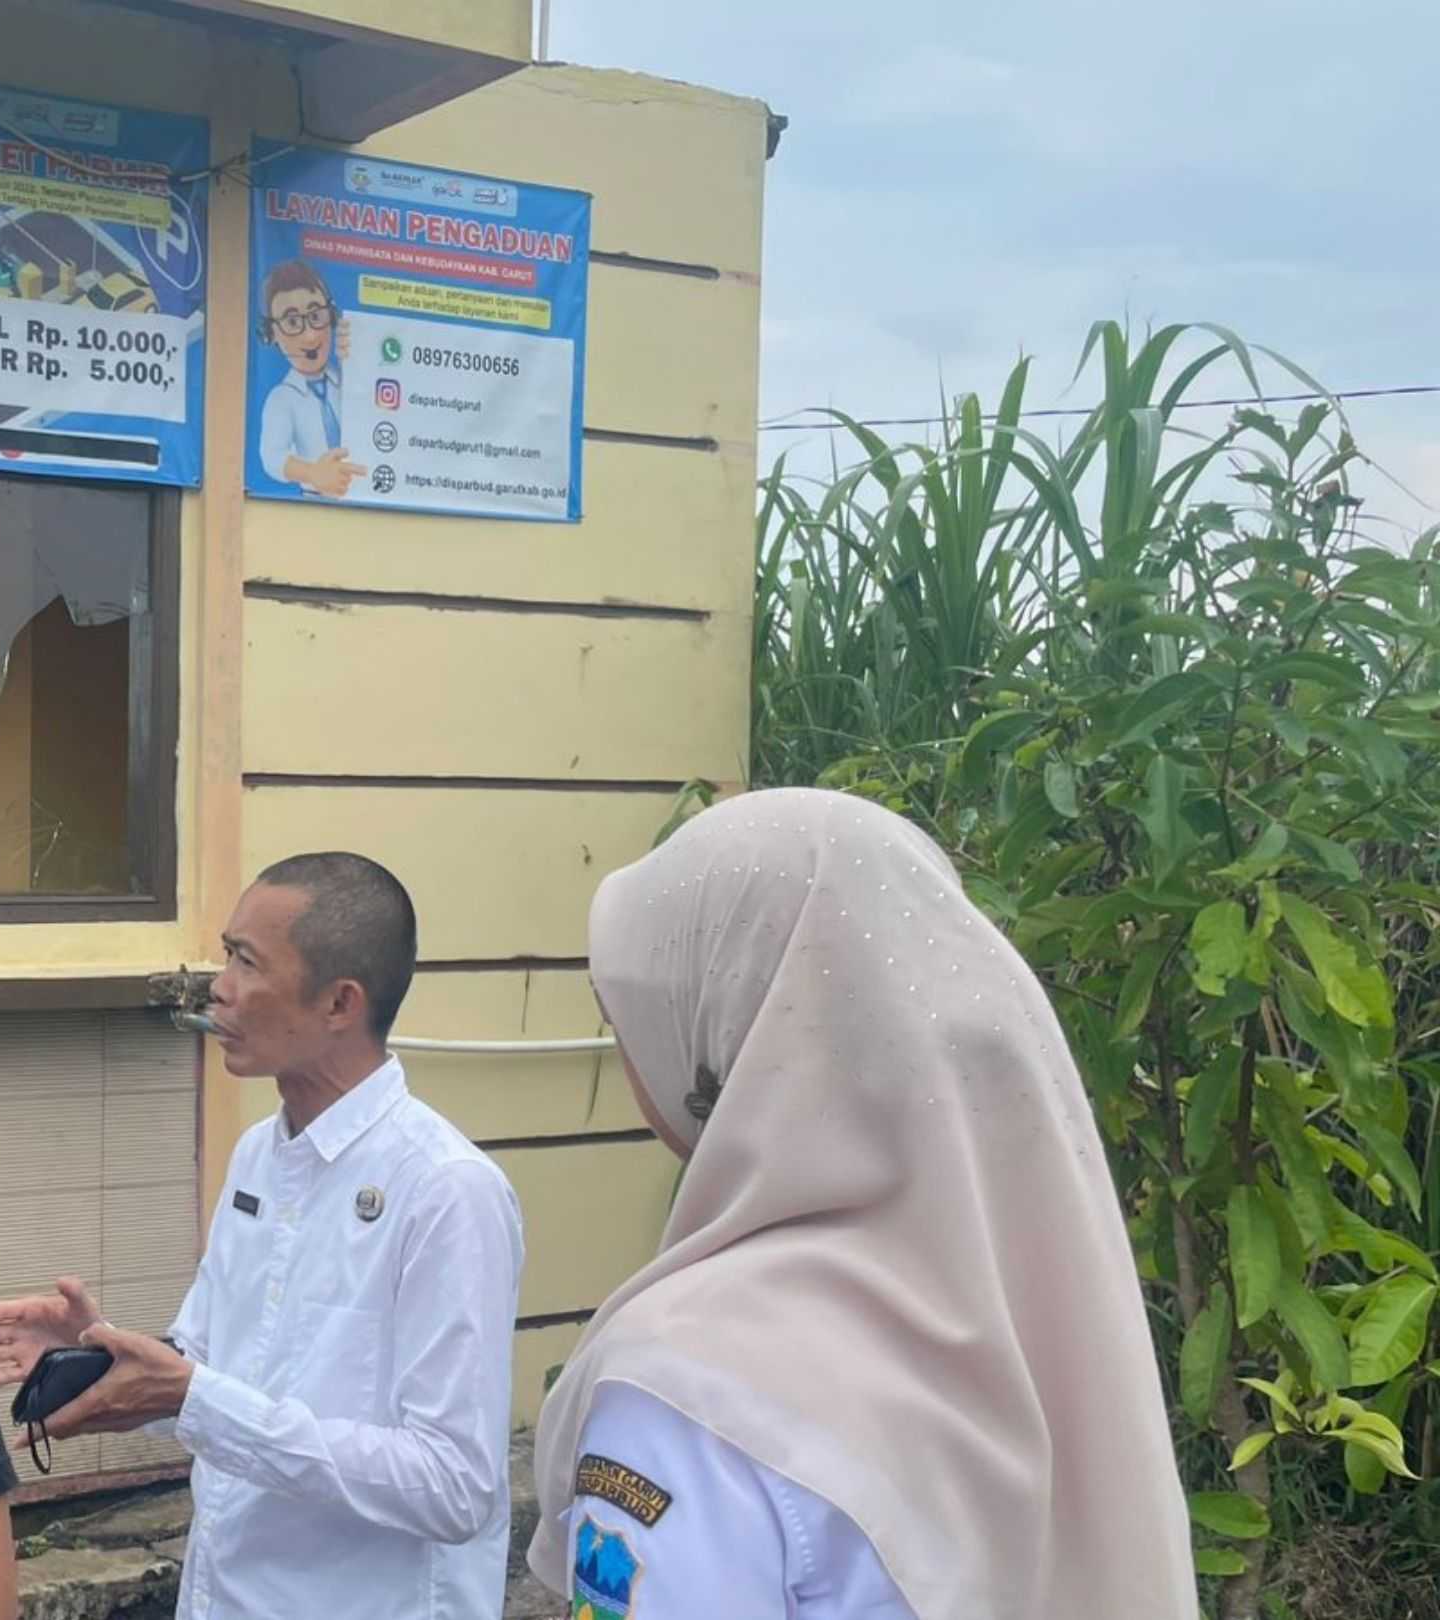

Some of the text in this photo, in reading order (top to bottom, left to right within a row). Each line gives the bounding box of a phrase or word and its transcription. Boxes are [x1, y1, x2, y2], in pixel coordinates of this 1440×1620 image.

[266, 188, 573, 264] LAYANAN PENGADUAN
[393, 252, 414, 265] DAN
[26, 320, 68, 350] Rp.
[26, 352, 68, 380] Rp.
[412, 346, 520, 377] 08976300656
[408, 393, 481, 413] disparbudgarut
